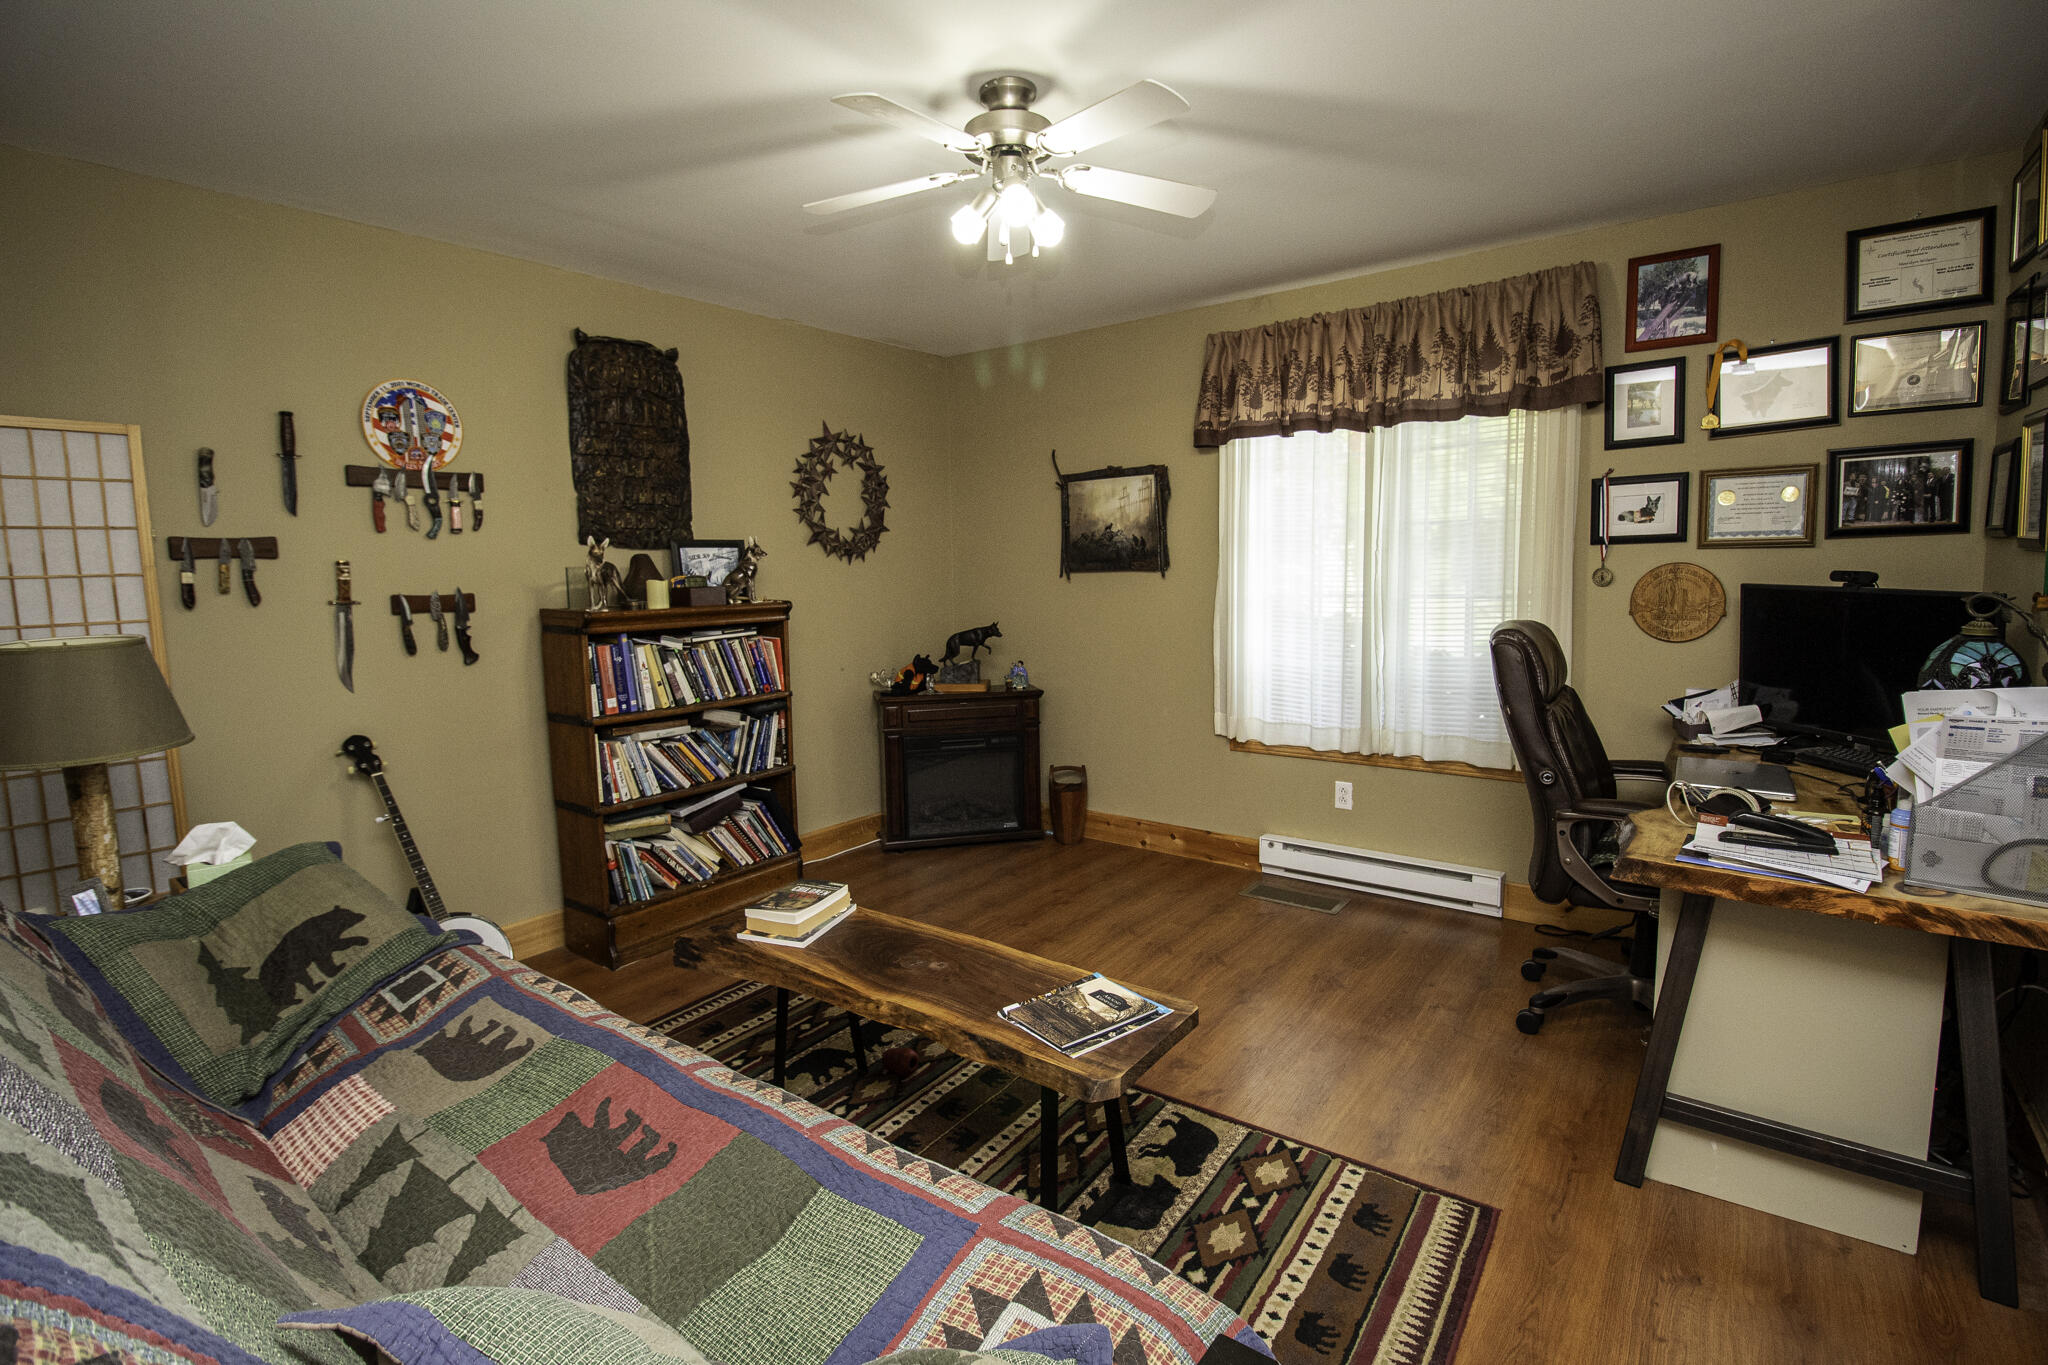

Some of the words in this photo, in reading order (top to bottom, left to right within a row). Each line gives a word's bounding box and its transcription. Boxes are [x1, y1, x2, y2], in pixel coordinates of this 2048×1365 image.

[1877, 246, 1913, 259] Certificate
[364, 390, 381, 423] SEPTEMBER
[406, 381, 431, 392] WORLD
[430, 388, 449, 407] TRADE
[446, 405, 460, 429] CENTER
